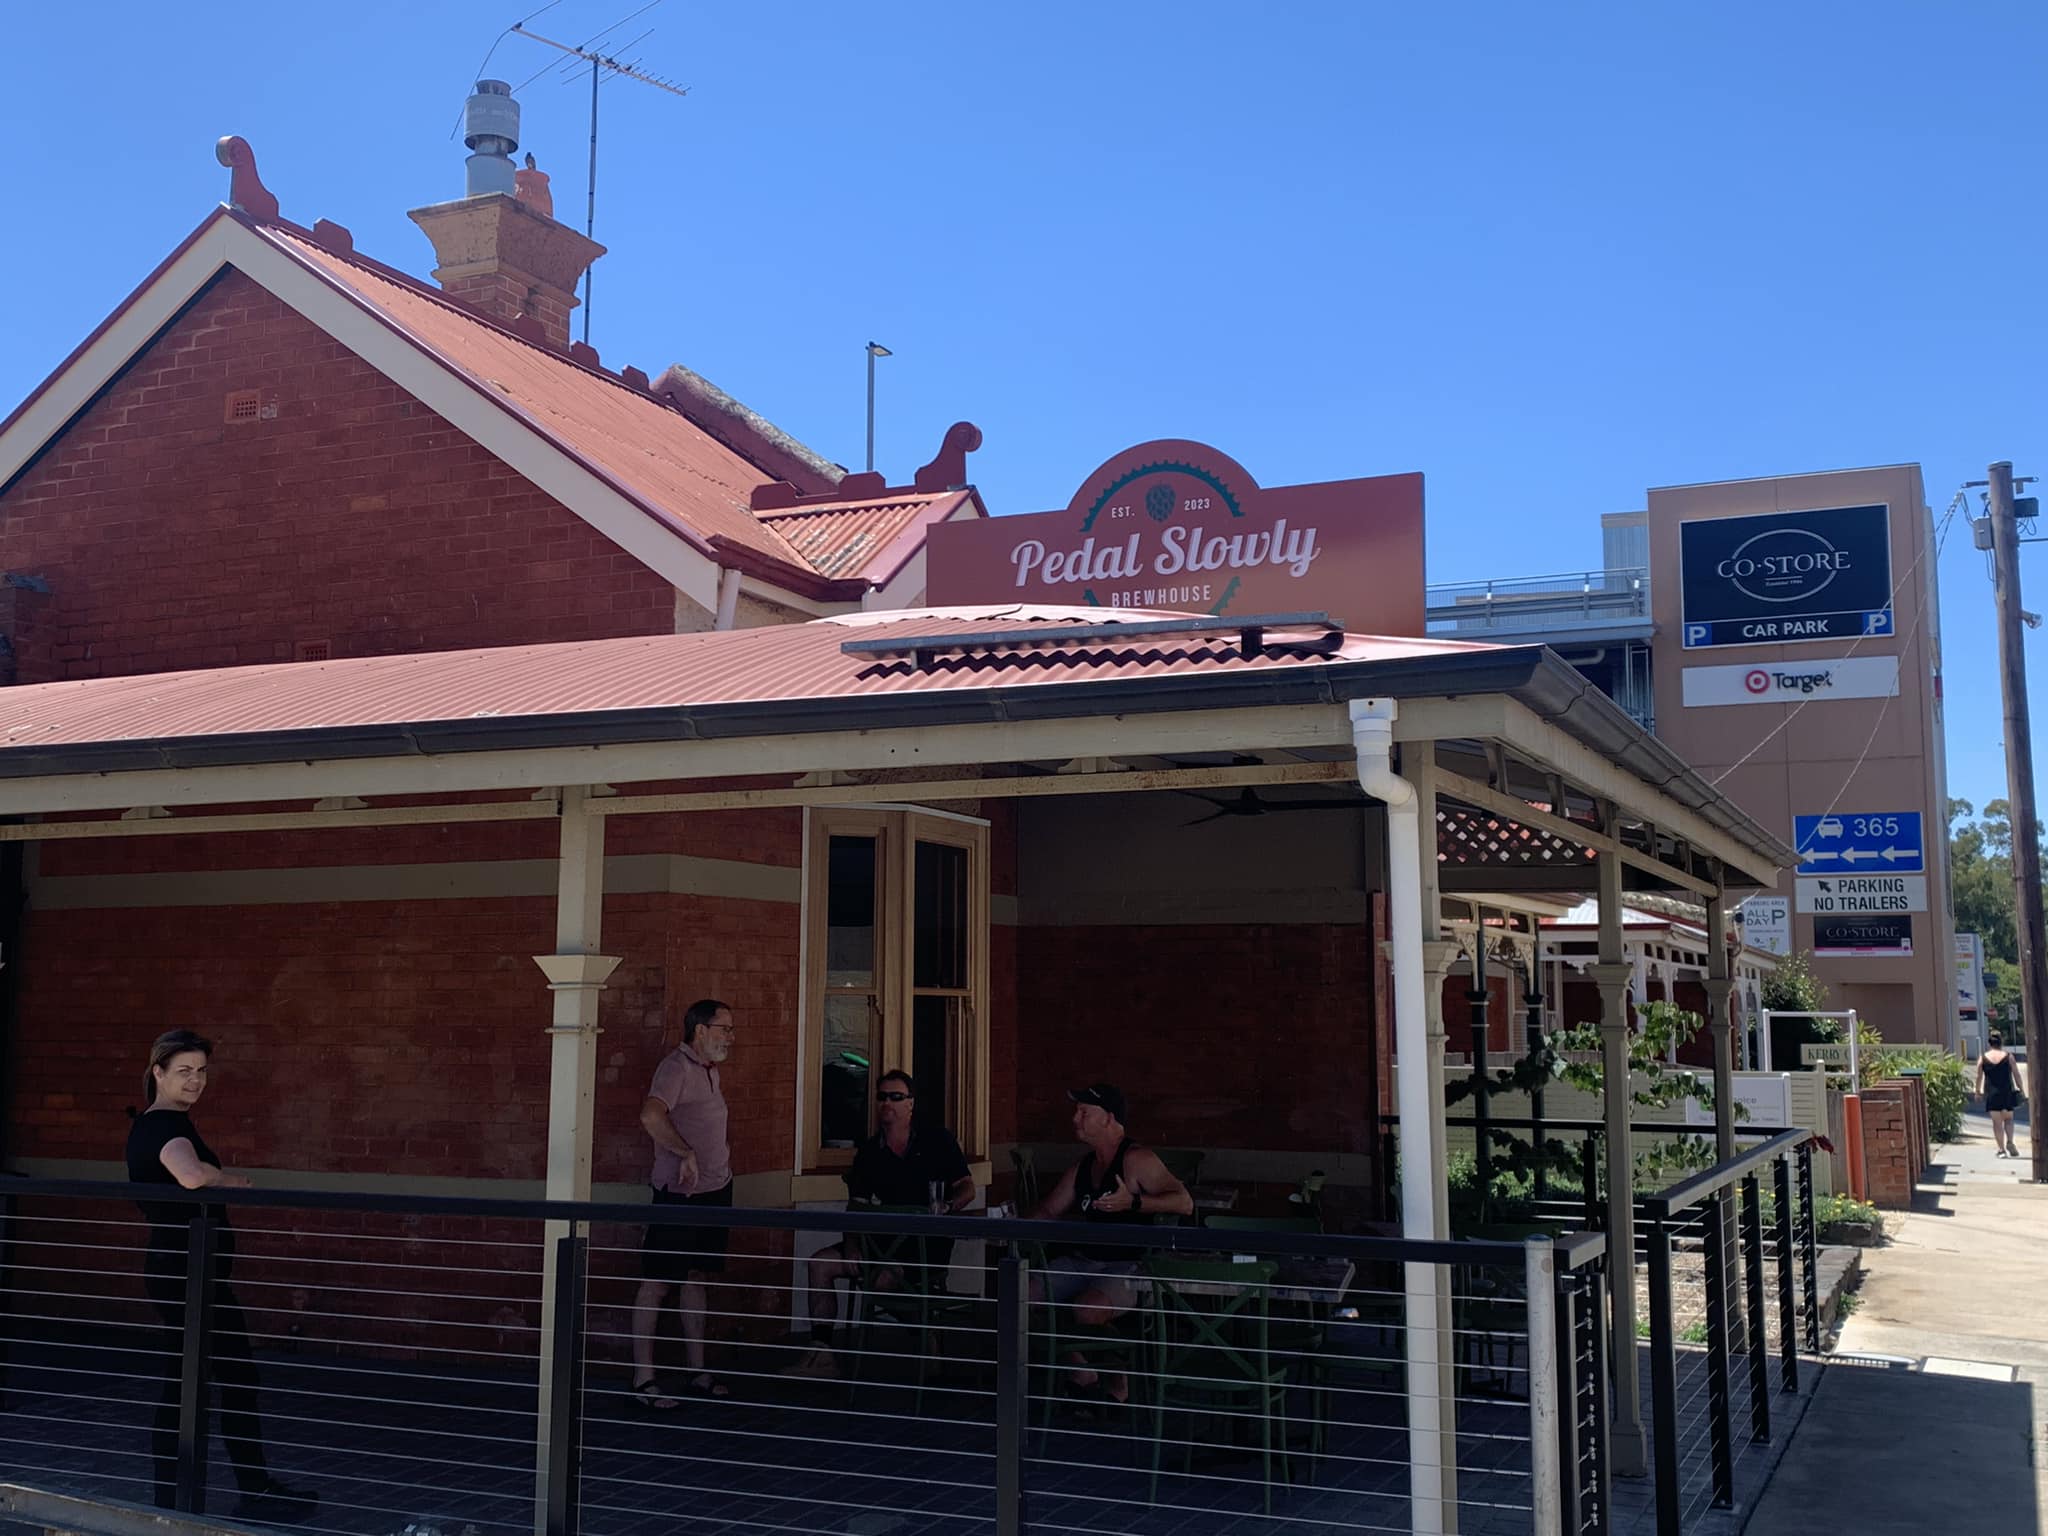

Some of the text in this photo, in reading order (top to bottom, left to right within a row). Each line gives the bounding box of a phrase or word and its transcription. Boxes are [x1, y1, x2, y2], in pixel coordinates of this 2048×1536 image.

[1111, 498, 1210, 518] EST. 2023
[1010, 518, 1321, 587] Pedal Slowly
[1111, 585, 1211, 608] BREWHOUSE
[1688, 614, 1887, 645] P CAR PARK P
[1772, 670, 1832, 693] Target
[1854, 817, 1899, 837] 365
[1838, 879, 1904, 893] PARKING
[1747, 909, 1768, 917] ALL
[1814, 895, 1908, 911] NO TRAILERS
[1747, 918, 1770, 926] DAY
